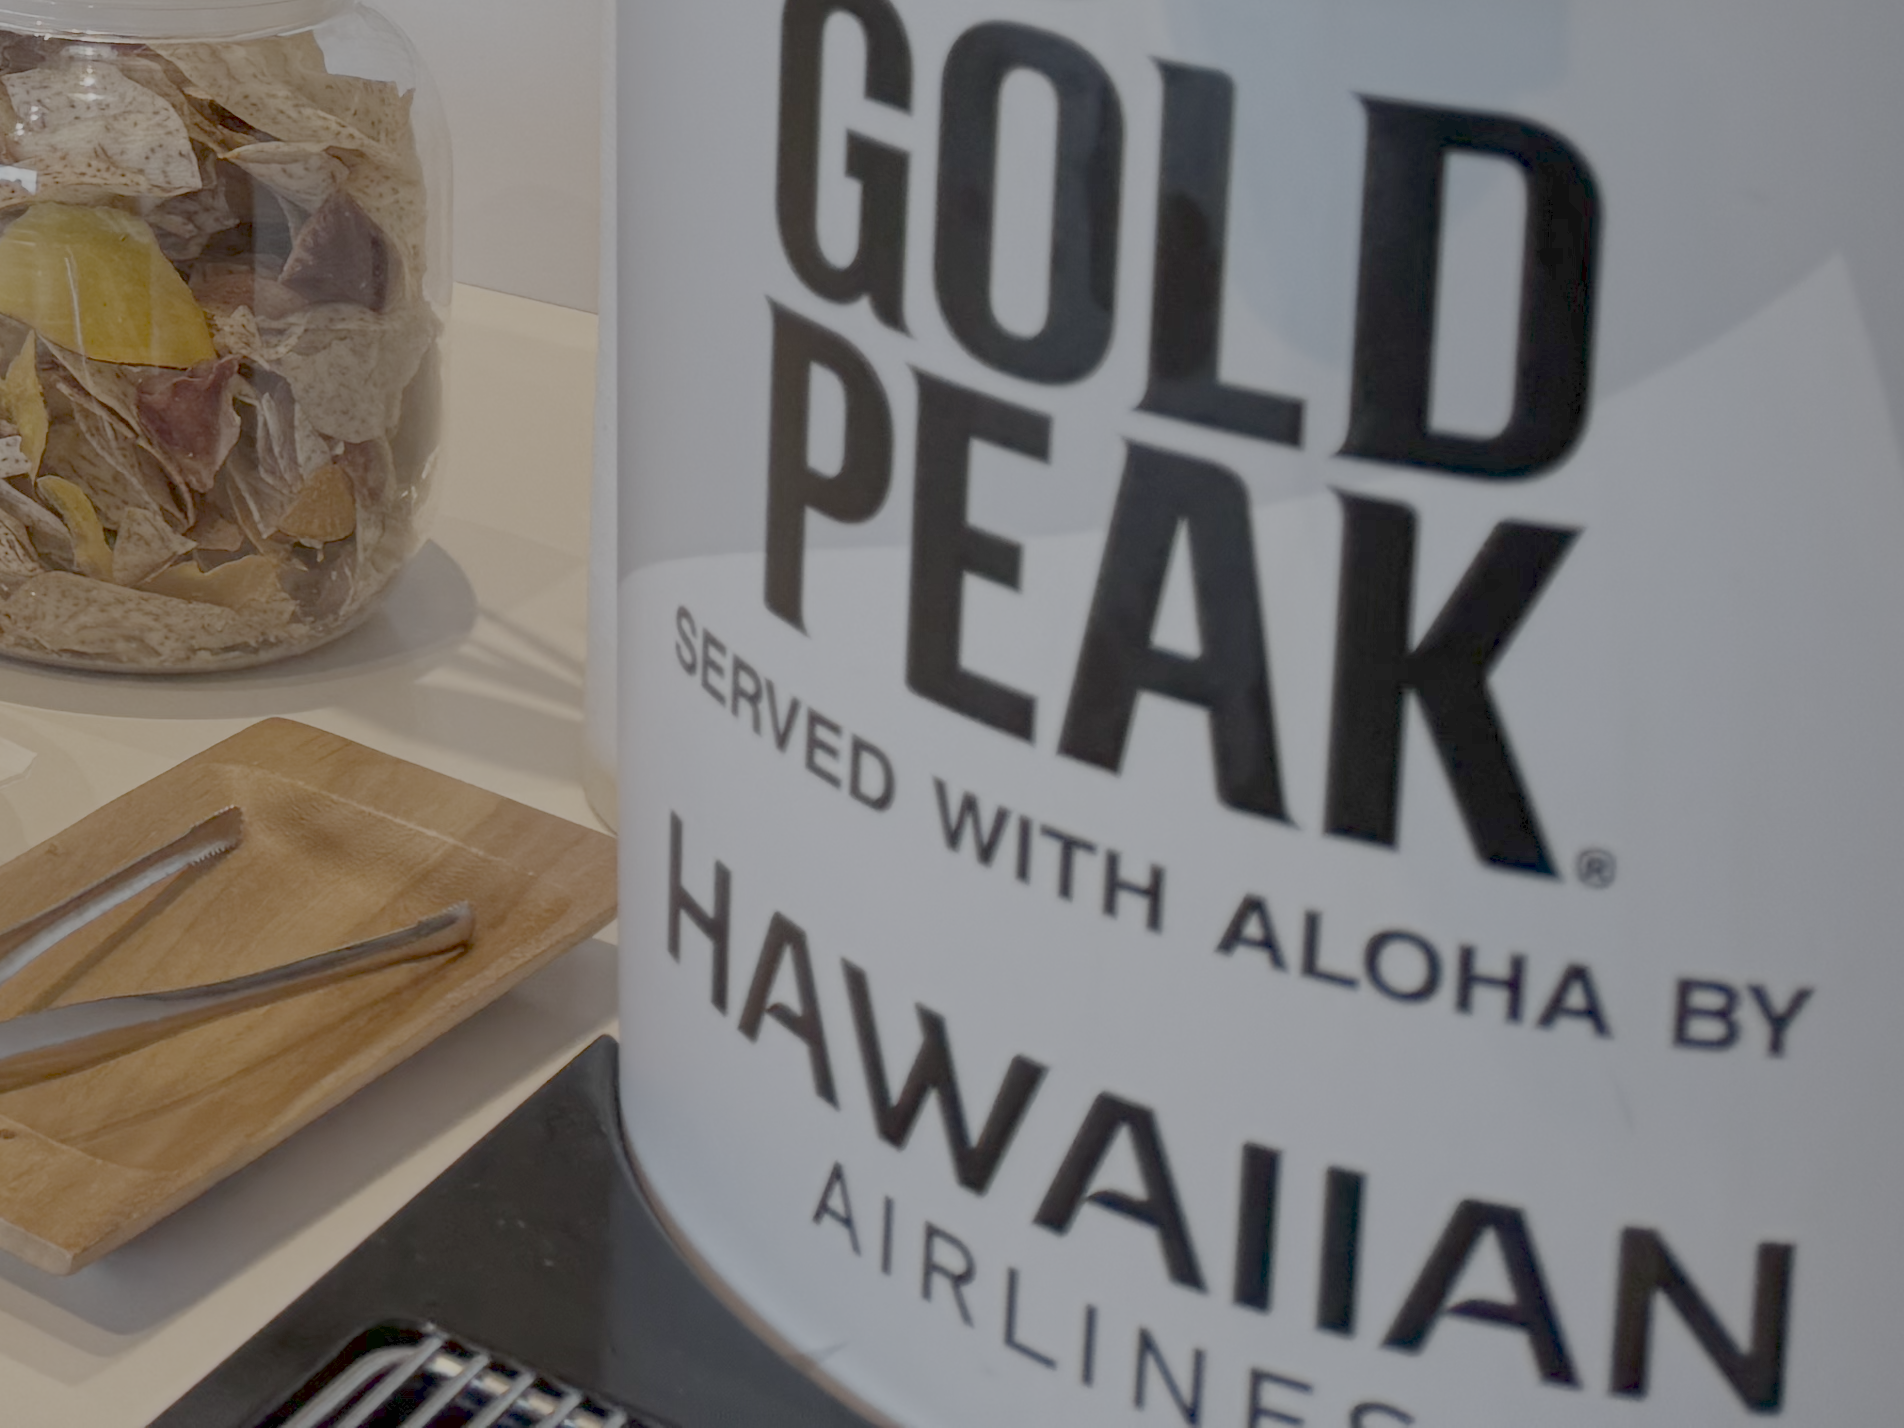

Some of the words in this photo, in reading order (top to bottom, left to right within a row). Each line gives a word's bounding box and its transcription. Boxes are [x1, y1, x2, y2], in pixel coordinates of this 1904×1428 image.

[673, 606, 897, 814] SERVED
[934, 777, 1168, 934] WITH
[1214, 894, 1615, 1040] ALOHA
[1669, 976, 1817, 1059] BY
[668, 810, 1796, 1418] HAWAIIAN
